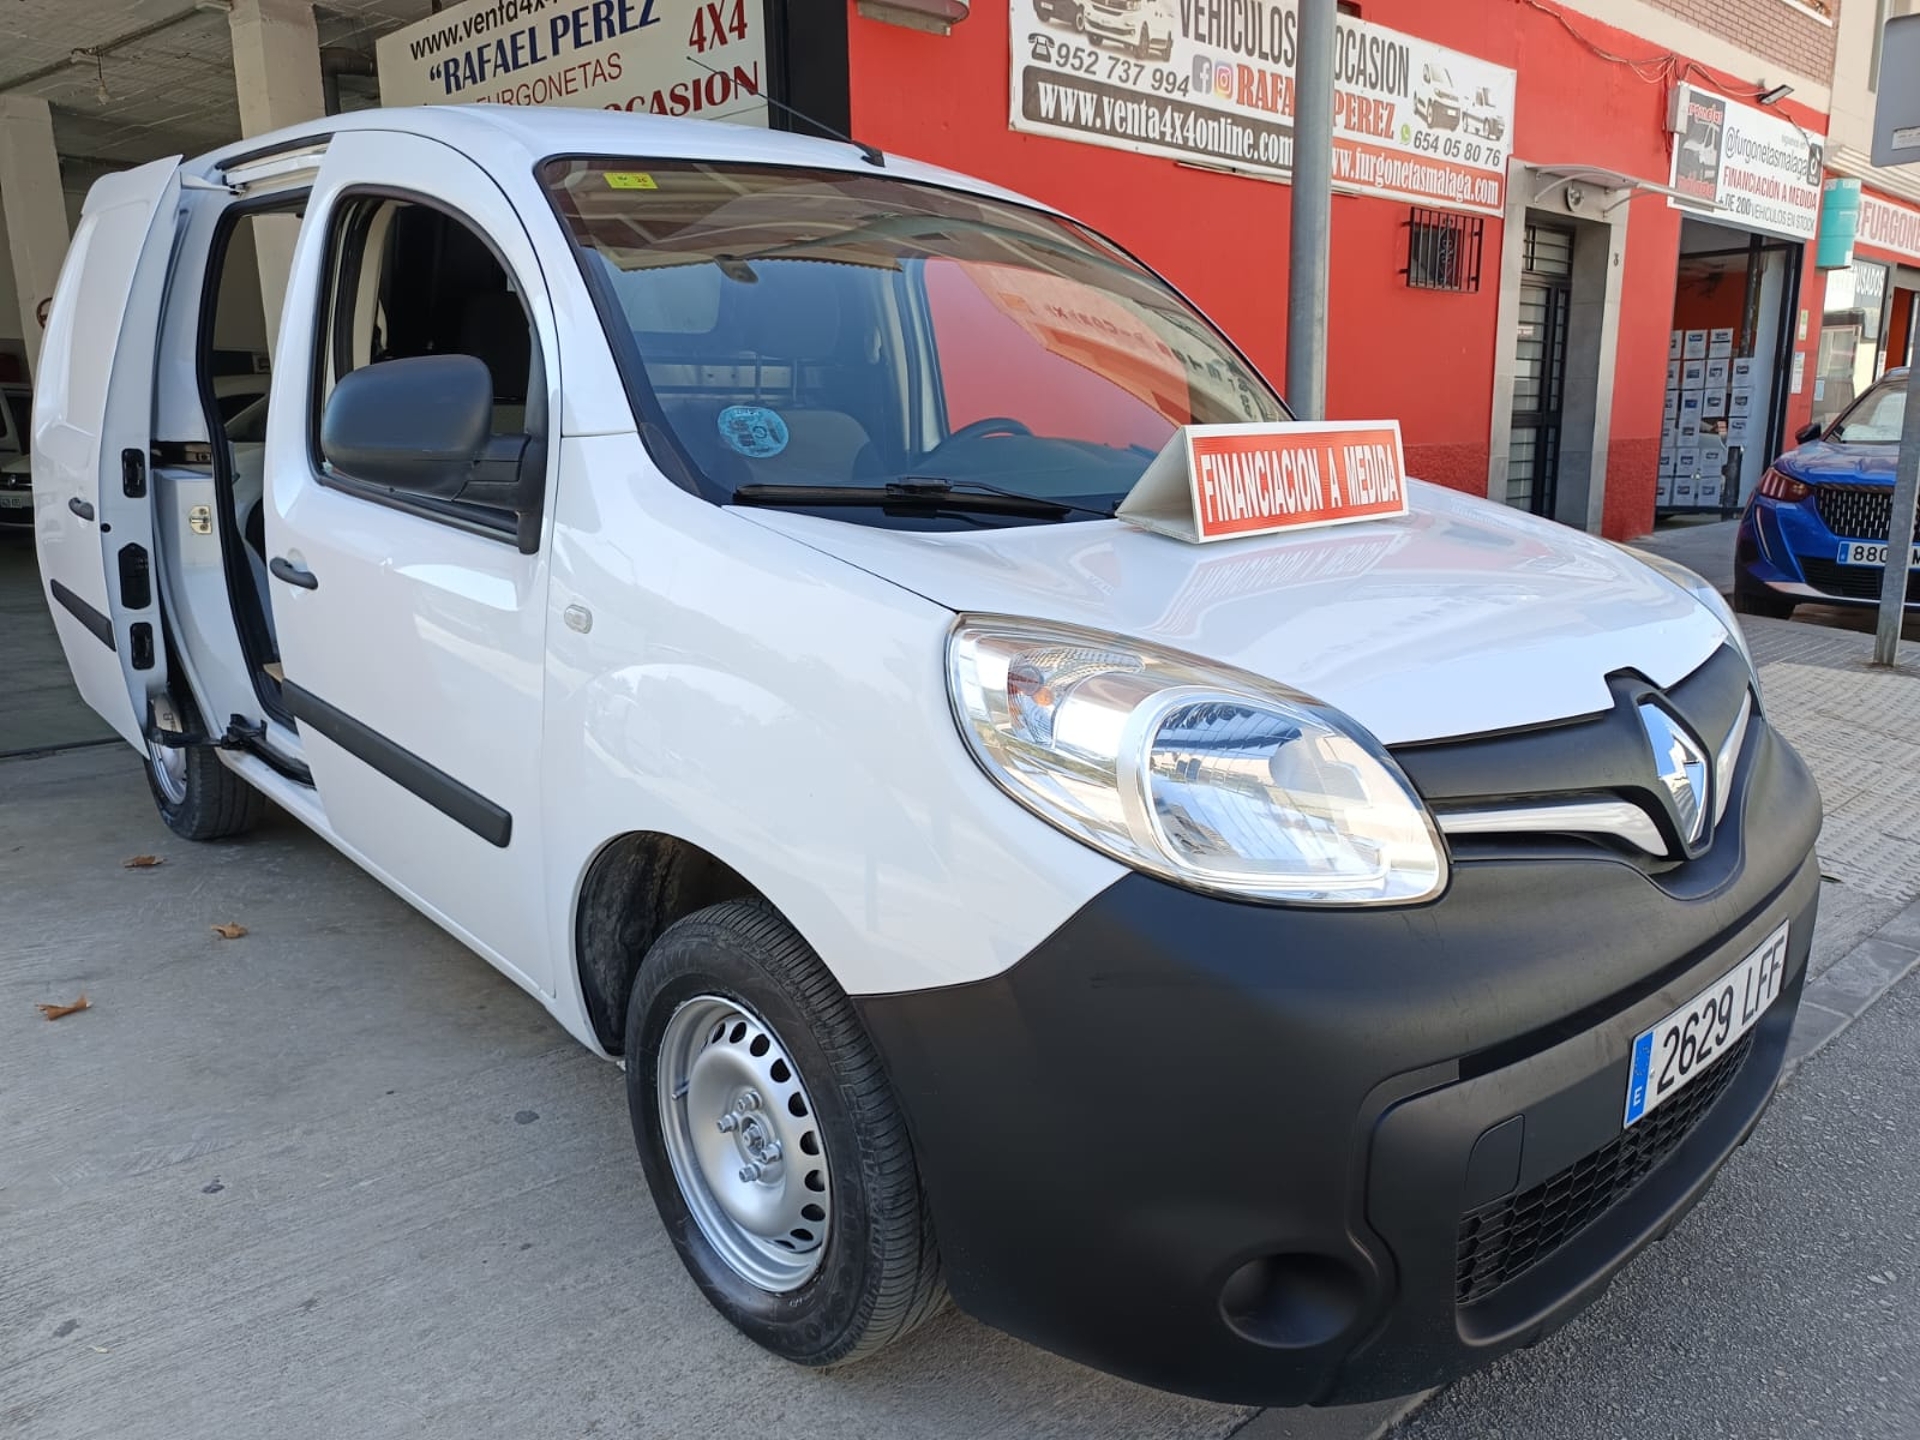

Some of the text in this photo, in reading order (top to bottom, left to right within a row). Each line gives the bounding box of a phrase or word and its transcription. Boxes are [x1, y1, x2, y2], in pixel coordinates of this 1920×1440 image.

[550, 0, 661, 57] PEREZ
[689, 0, 748, 53] 4X4
[1179, 0, 1296, 67] VEHICULOS
[476, 53, 623, 107] RGONETAS
[1055, 43, 1099, 75] 952
[1106, 55, 1146, 86] 737
[1151, 68, 1190, 97] 994
[1333, 89, 1396, 140] PEREZ
[1414, 130, 1502, 167] 654 05 80 76
[1781, 182, 1788, 203] A
[1200, 444, 1400, 523] FINANCIACION A MEDIDA
[1656, 935, 1785, 1095] 2629 LFF
[1633, 1085, 1642, 1107] E
